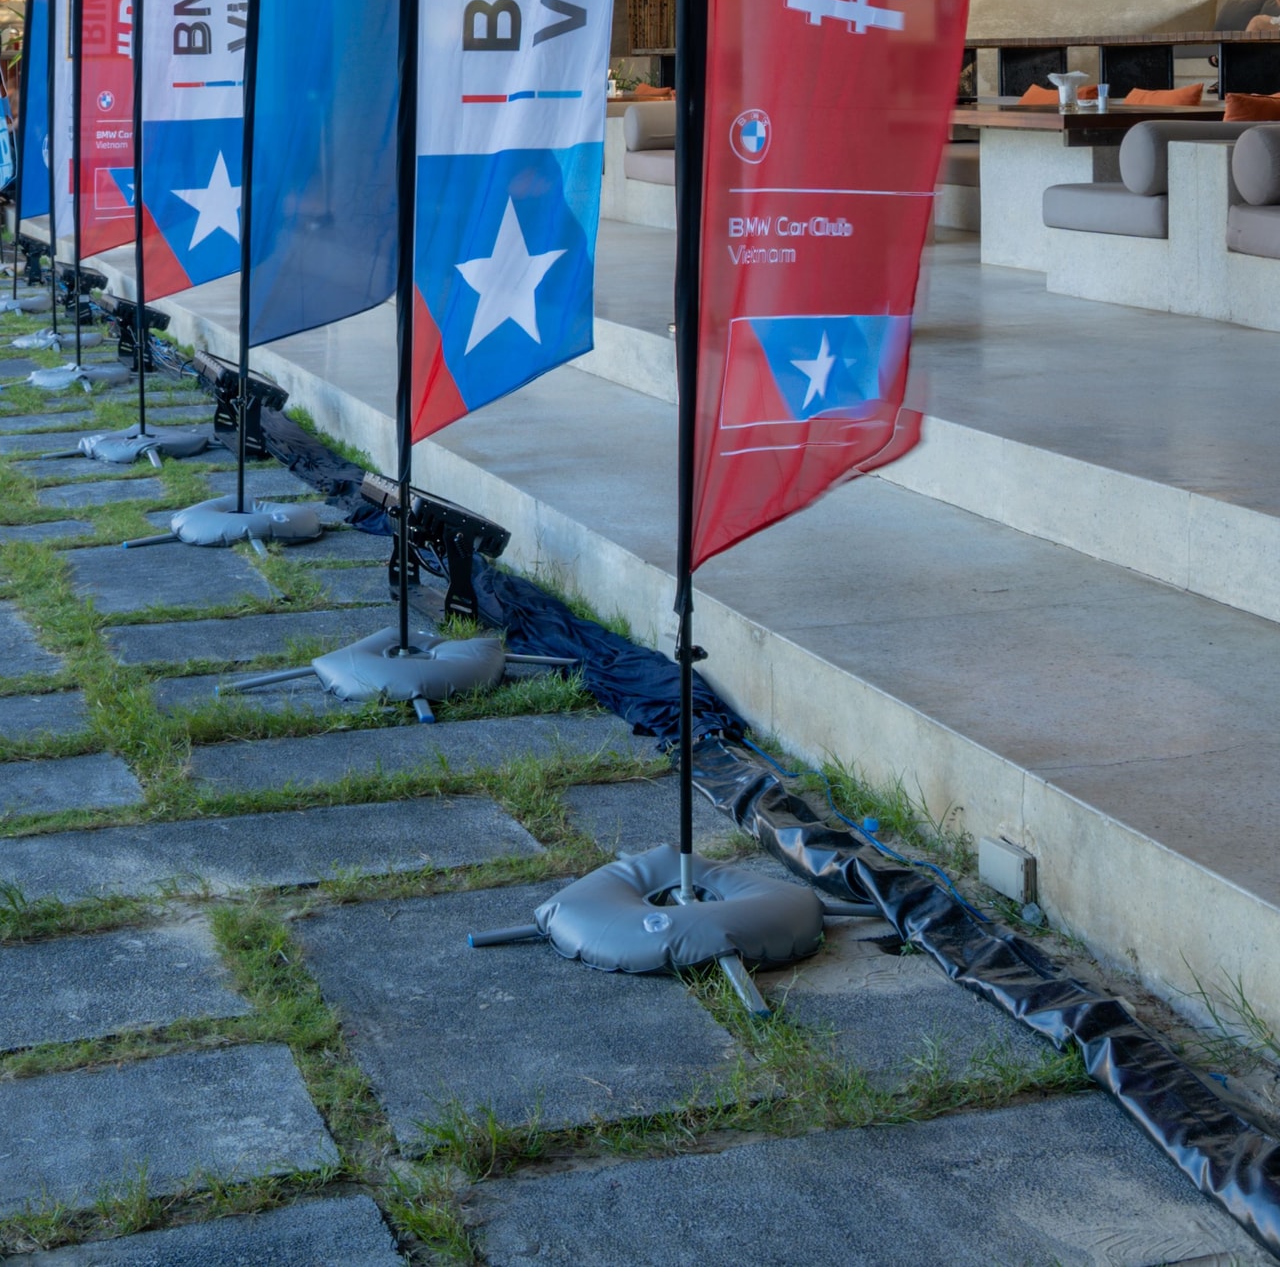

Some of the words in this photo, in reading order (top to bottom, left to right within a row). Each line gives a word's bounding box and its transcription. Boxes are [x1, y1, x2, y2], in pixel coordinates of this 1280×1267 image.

[96, 130, 117, 139] BMW
[118, 130, 133, 139] Car
[95, 141, 128, 149] Vietnam
[728, 216, 771, 238] BMW
[775, 216, 808, 236] Car
[728, 244, 796, 265] Vietnam
